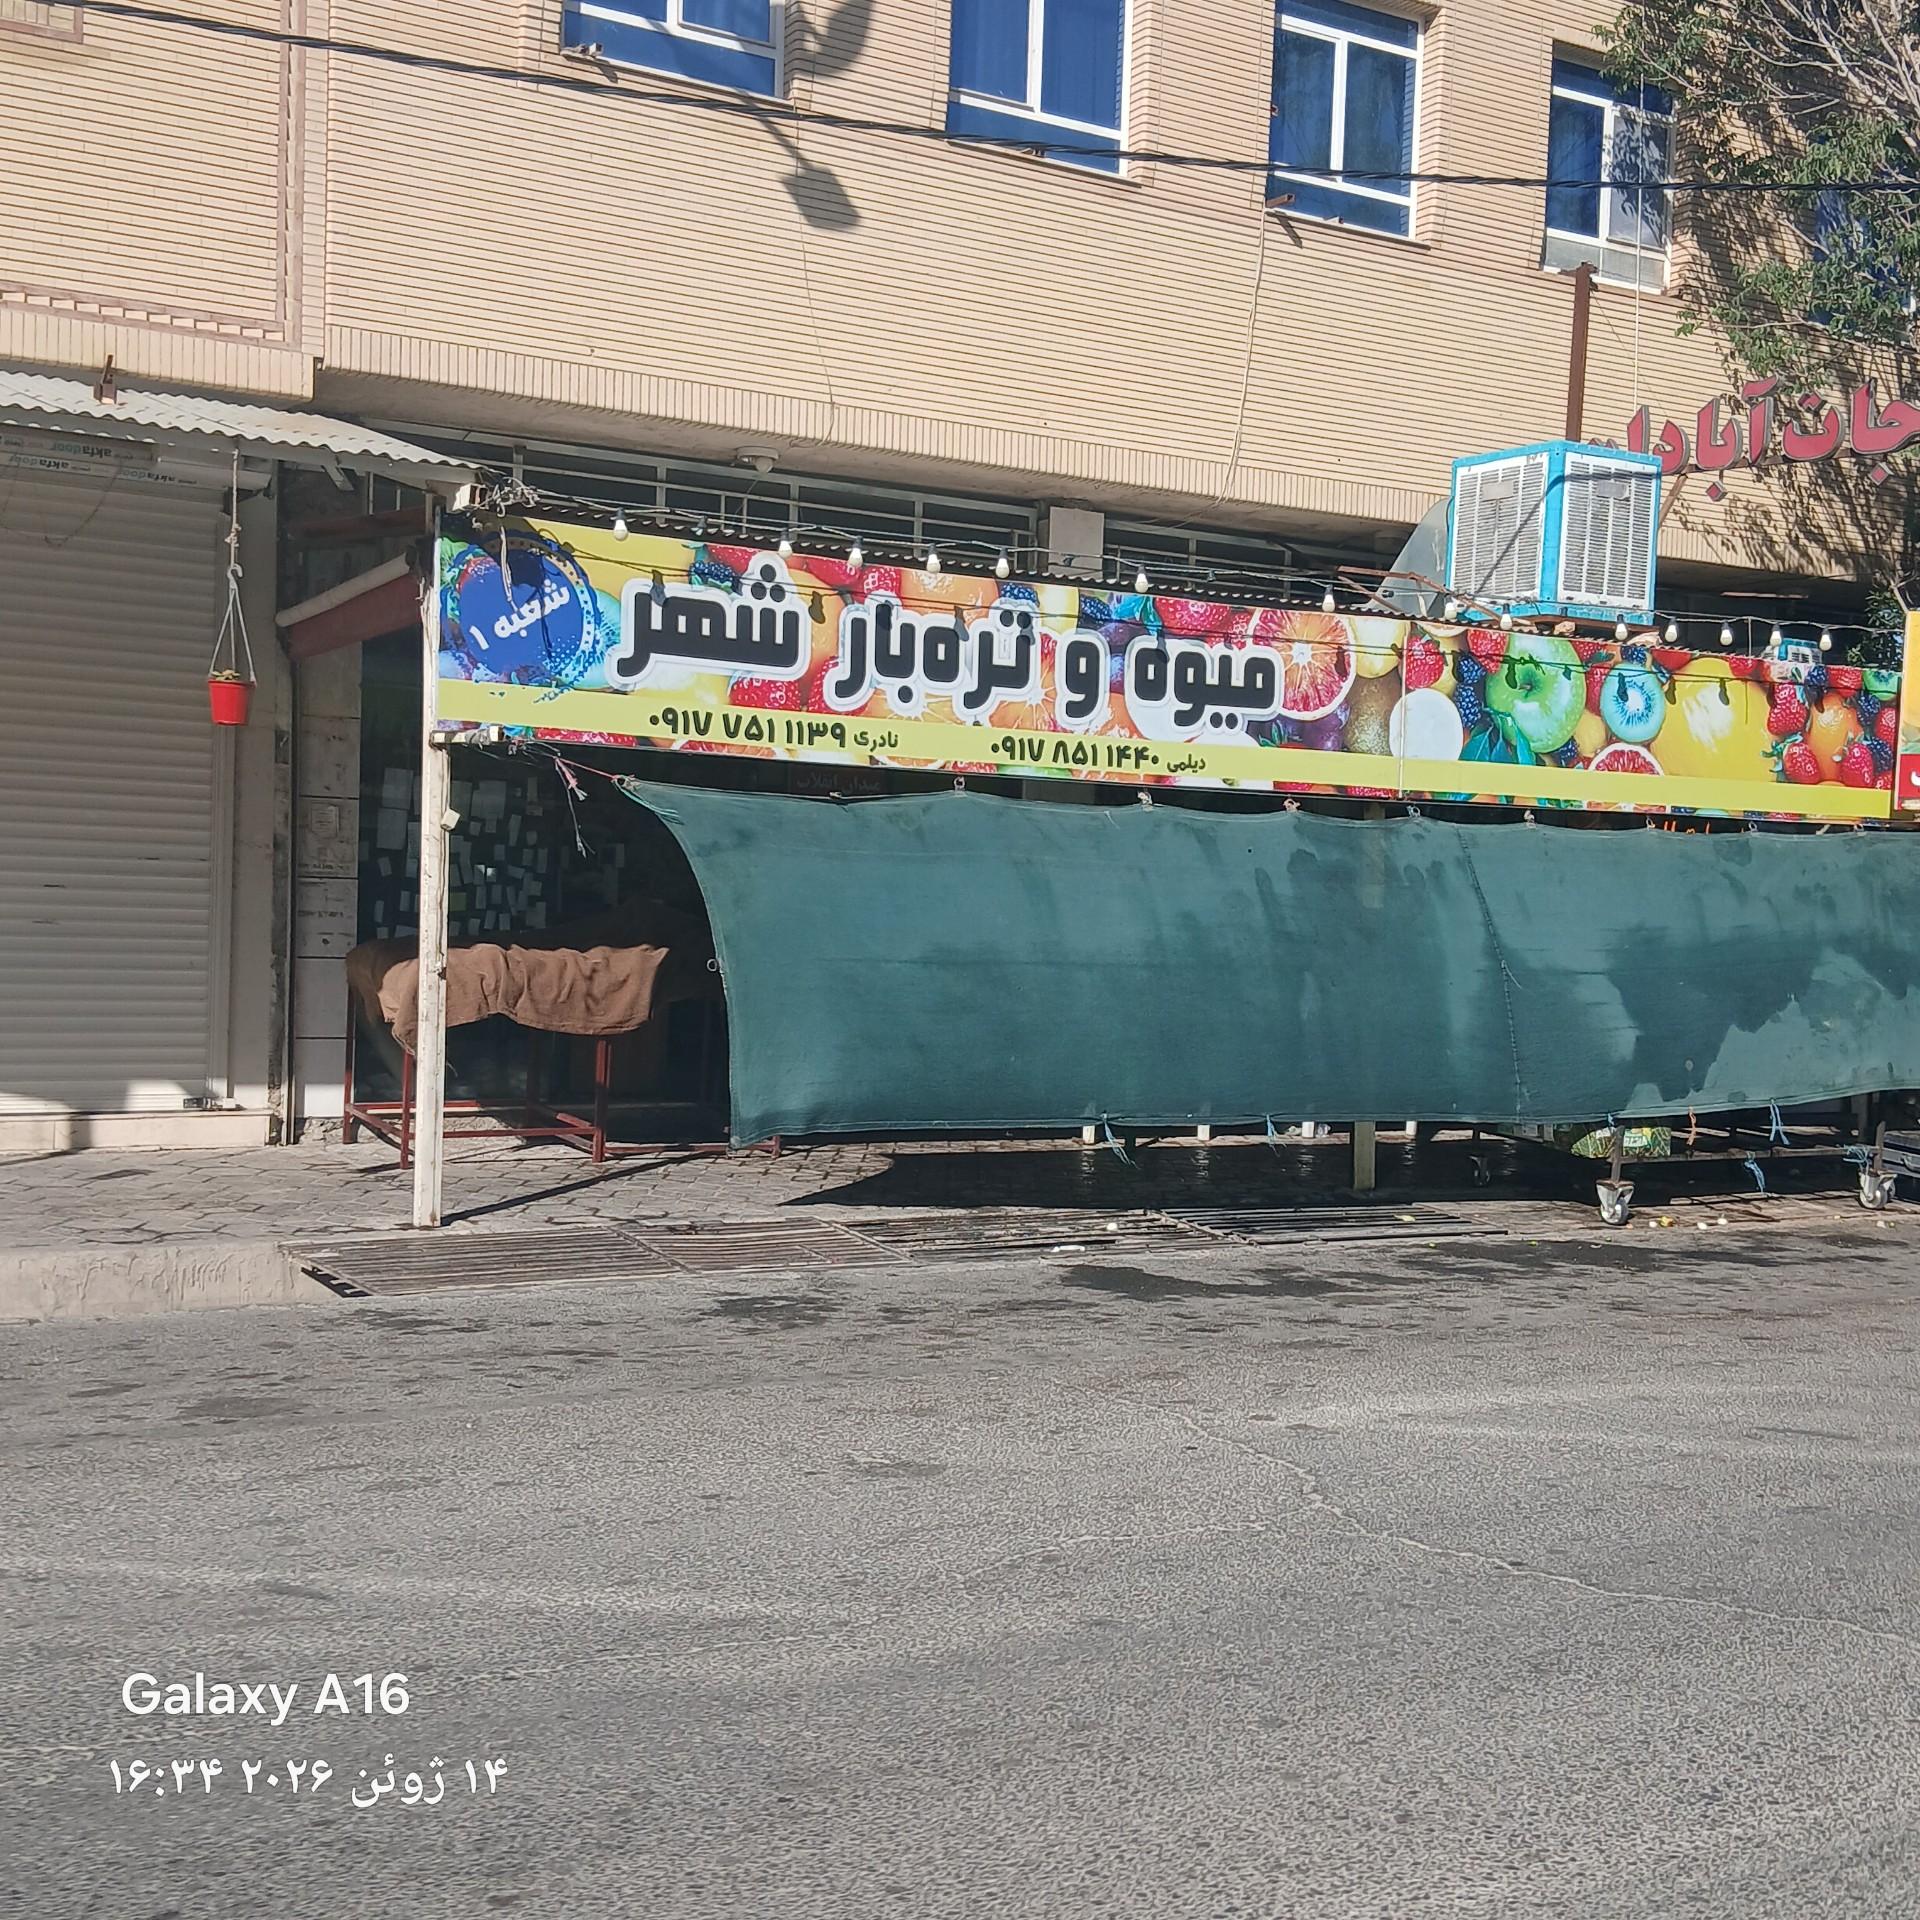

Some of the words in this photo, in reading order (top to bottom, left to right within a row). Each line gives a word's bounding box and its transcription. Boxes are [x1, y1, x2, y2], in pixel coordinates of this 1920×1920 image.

[493, 578, 571, 639] شعبه
[615, 562, 801, 679] شهر
[1064, 639, 1102, 720] و
[1132, 645, 1279, 731] میوه
[649, 707, 713, 736] ۰۹۱۷
[722, 713, 775, 743] ۷۵۱
[785, 718, 847, 748] ۱۱۳۹
[853, 730, 899, 752] نادری
[991, 736, 1045, 762] ۰۹۱۷
[1052, 740, 1098, 766] ۸۵۱
[1106, 744, 1160, 769] ۱۴۴۰
[1166, 753, 1206, 773] دیلمی
